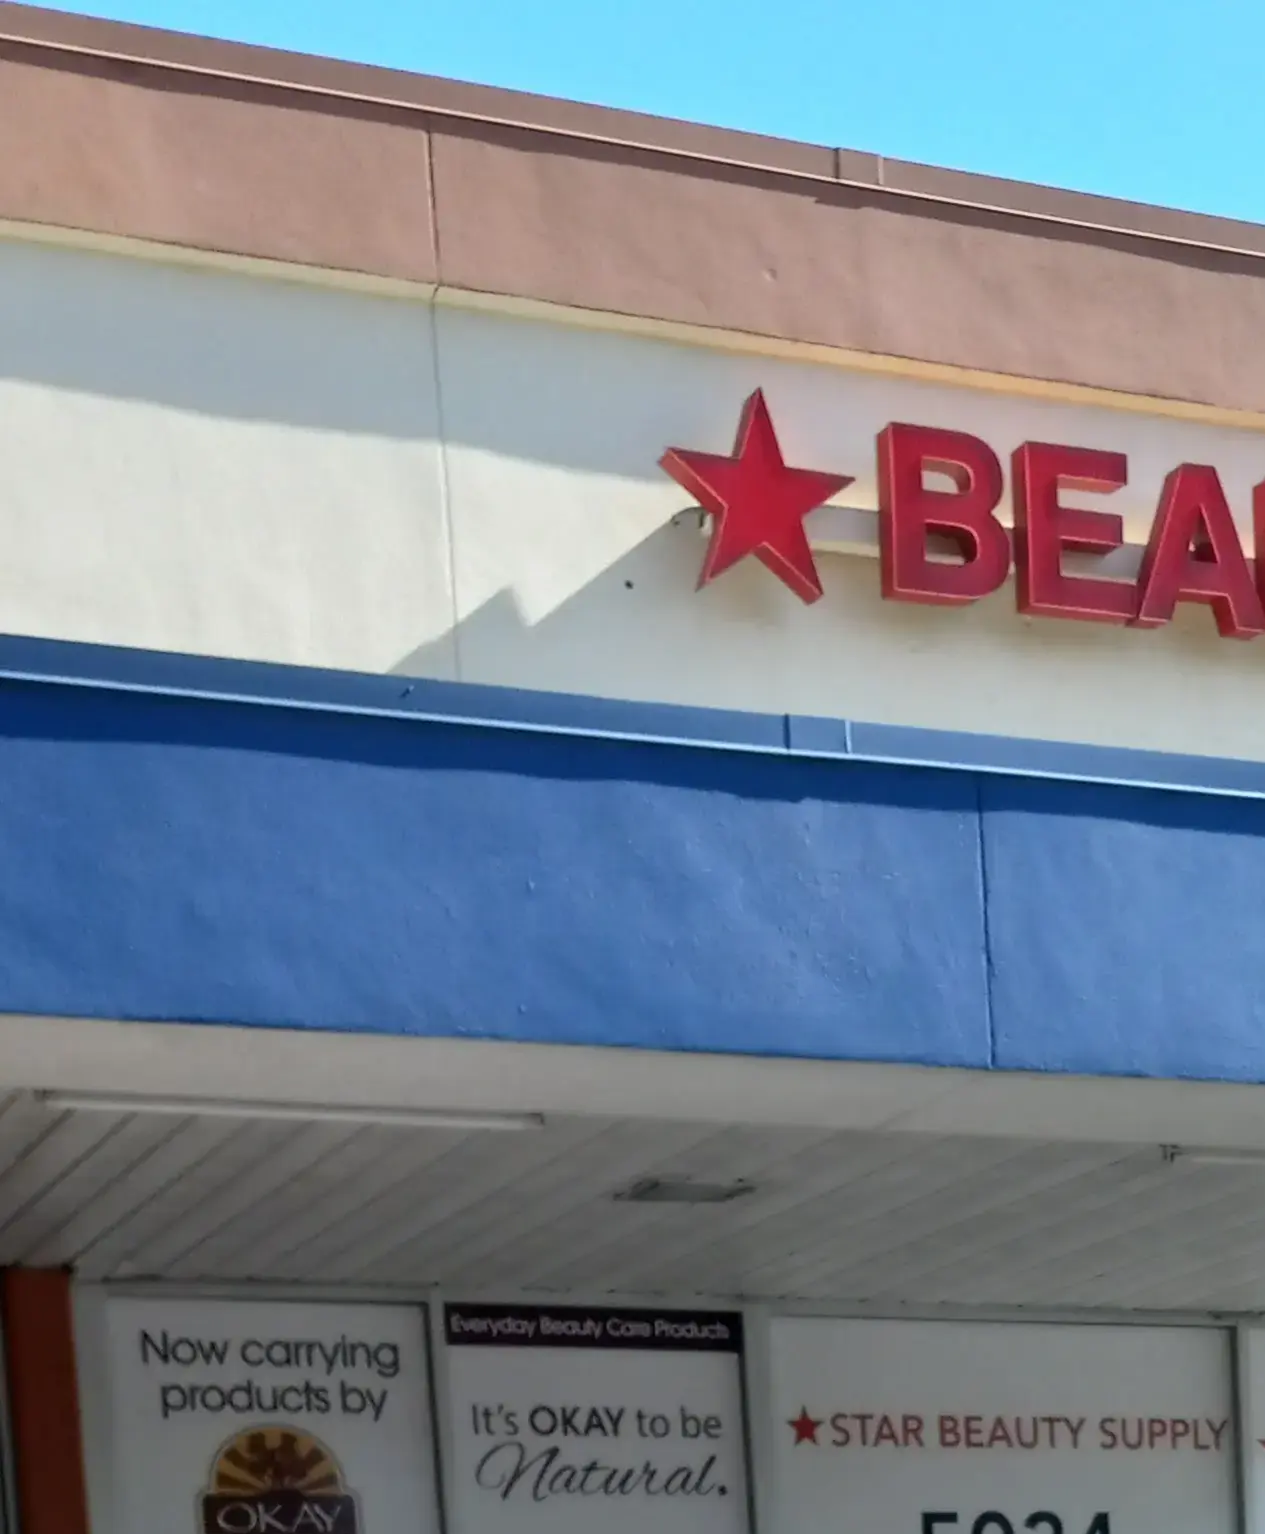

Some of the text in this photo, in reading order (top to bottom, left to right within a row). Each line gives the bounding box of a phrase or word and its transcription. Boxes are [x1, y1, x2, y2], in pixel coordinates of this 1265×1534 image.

[451, 1313, 731, 1339] Everyday Beauty Care Products
[139, 1329, 399, 1377] Now carrying
[160, 1380, 388, 1421] products by
[471, 1404, 723, 1438] It's OKAY to be
[829, 1412, 1228, 1451] STAR BEAUTY SUPPLY
[474, 1441, 728, 1502] Natural.
[216, 1502, 342, 1533] OKAY
